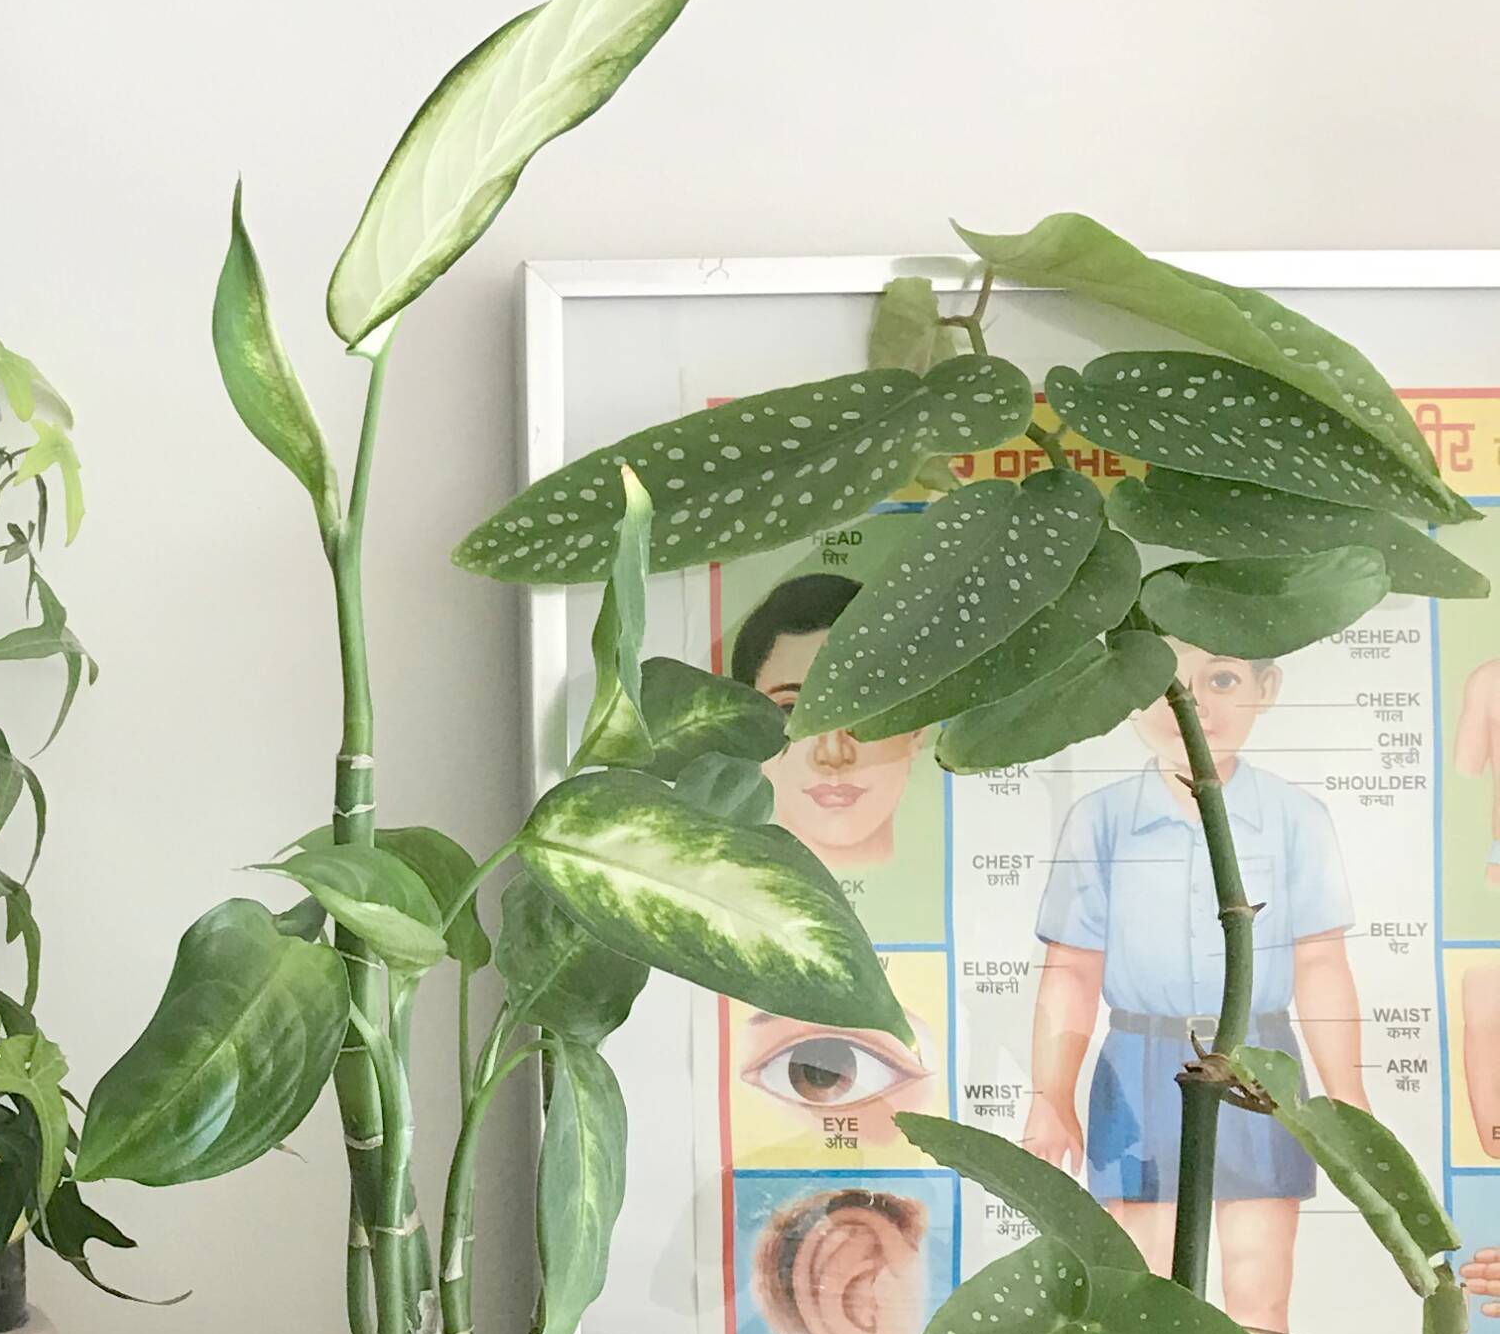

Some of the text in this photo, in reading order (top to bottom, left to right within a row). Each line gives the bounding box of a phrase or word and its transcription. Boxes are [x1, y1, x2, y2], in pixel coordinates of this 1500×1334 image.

[1064, 449, 1127, 477] HE
[811, 530, 863, 546] HEAD
[821, 547, 850, 565] सिर
[1320, 629, 1421, 645] OREHEAD
[1349, 646, 1392, 659] ललाट
[1356, 692, 1421, 708] CHEEK
[1373, 709, 1404, 722] गाल
[1377, 732, 1423, 747] CHIN
[988, 778, 1021, 796] गर्दन
[1325, 775, 1428, 791] SHOULDER
[972, 854, 1035, 869] CHEST
[986, 870, 1021, 886] छाती
[1370, 922, 1429, 937] BELLY
[1387, 938, 1410, 955] पेट
[963, 961, 1031, 976] ELBOW
[975, 977, 1020, 995] कोहनी
[1372, 1007, 1432, 1023] WAIST
[1386, 1026, 1421, 1040] कमर
[1386, 1058, 1429, 1074] ARM
[963, 1084, 1023, 1100] WRIST
[973, 1101, 1016, 1119] कलाई
[822, 1116, 859, 1132] EYE
